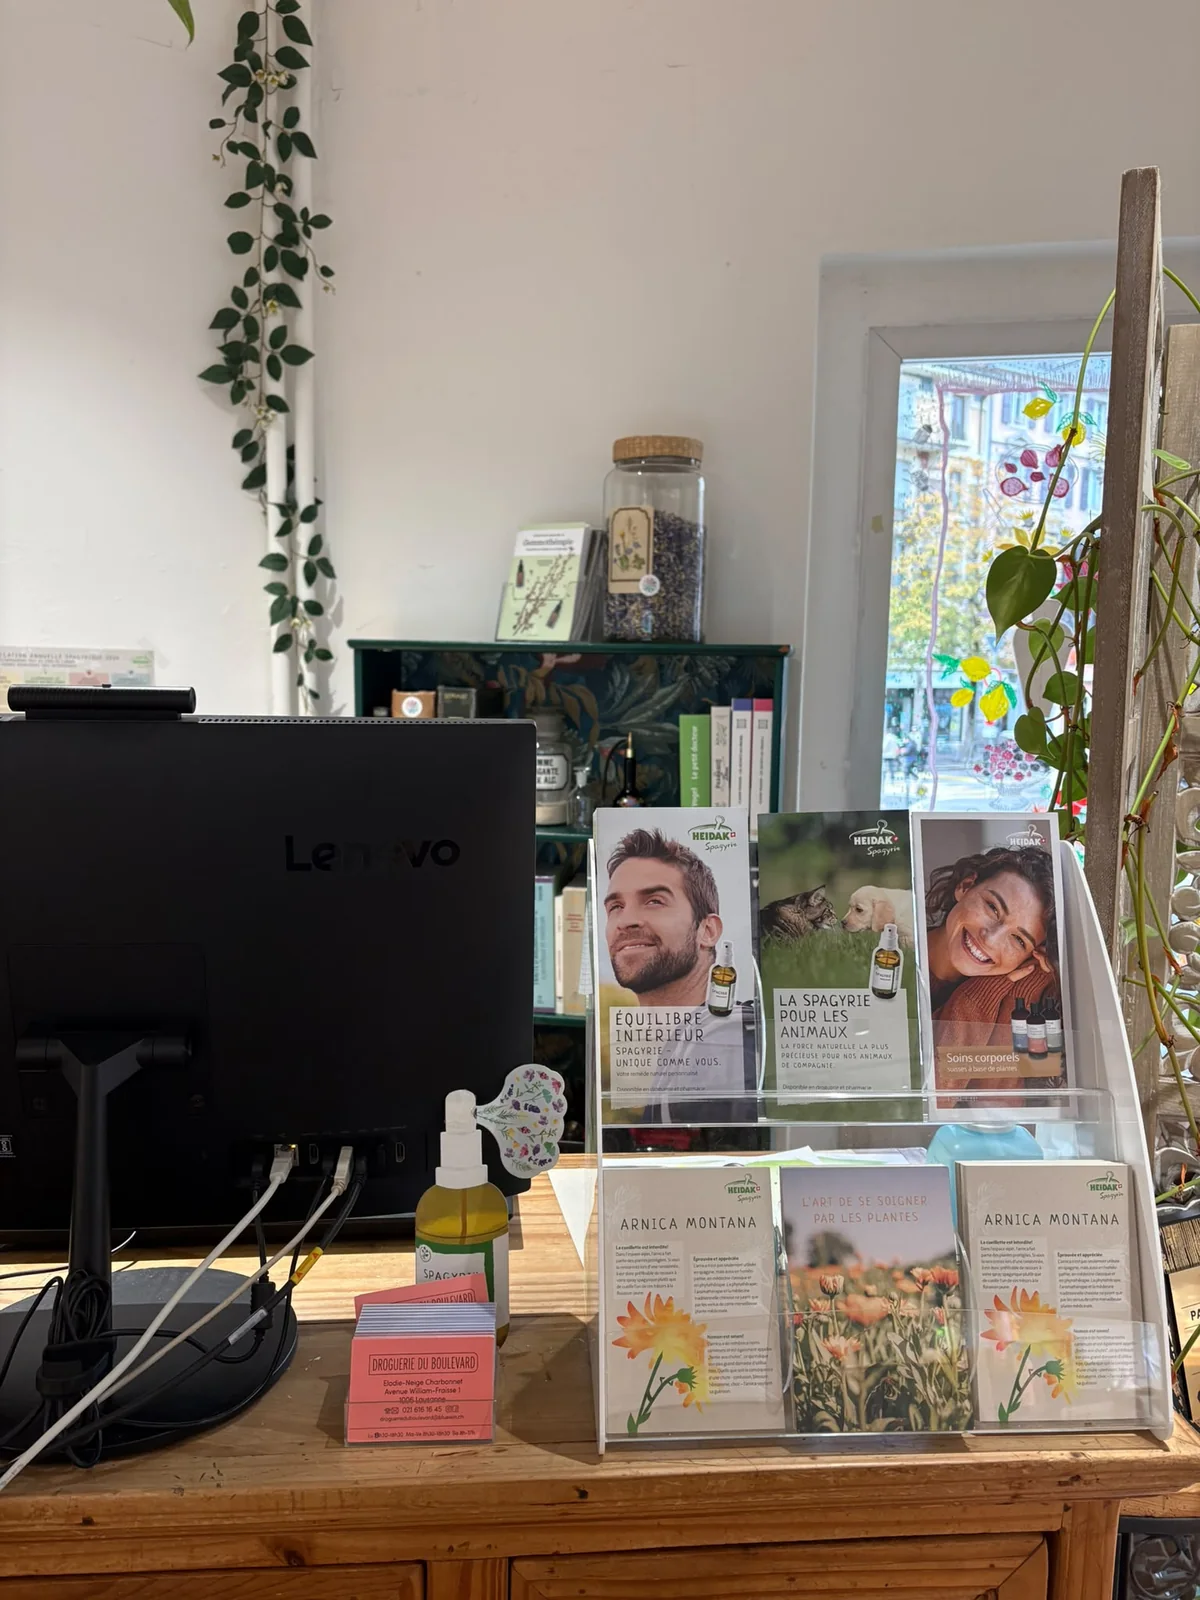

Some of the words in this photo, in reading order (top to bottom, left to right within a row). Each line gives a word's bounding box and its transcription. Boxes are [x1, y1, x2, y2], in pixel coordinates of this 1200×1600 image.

[692, 832, 730, 840] HEIDAK
[854, 836, 893, 846] HEIDAK
[284, 835, 460, 872] Lenvo
[780, 994, 797, 1006] LA
[803, 994, 870, 1007] SPAGYRIE
[616, 1010, 702, 1028] ÉQUILIBRE
[780, 1010, 816, 1022] POUR
[824, 1010, 848, 1022] LES
[616, 1026, 704, 1042] INTÉRIEUR
[780, 1026, 848, 1038] ANIMAUX
[616, 1046, 662, 1055] SPAGYRIE
[616, 1058, 651, 1068] UNIQUE
[657, 1058, 690, 1066] COMME
[695, 1058, 722, 1066] VOUS.
[946, 1053, 973, 1063] Soins
[975, 1052, 1020, 1064] corporels
[802, 1197, 832, 1207] L'ART
[840, 1197, 853, 1207] DE
[858, 1197, 870, 1206] SE
[878, 1196, 927, 1206] SOIGNER
[620, 1217, 678, 1230] ARNICA
[686, 1216, 756, 1229] MONTANA
[814, 1213, 835, 1224] PAR
[842, 1212, 861, 1223] LES
[868, 1212, 919, 1223] PLANTES
[984, 1214, 1042, 1226] ARNICA
[1049, 1213, 1120, 1225] MONTANA
[372, 1357, 415, 1371] DROGUERIE
[417, 1357, 428, 1370] DU
[432, 1356, 475, 1370] BOULEVARD
